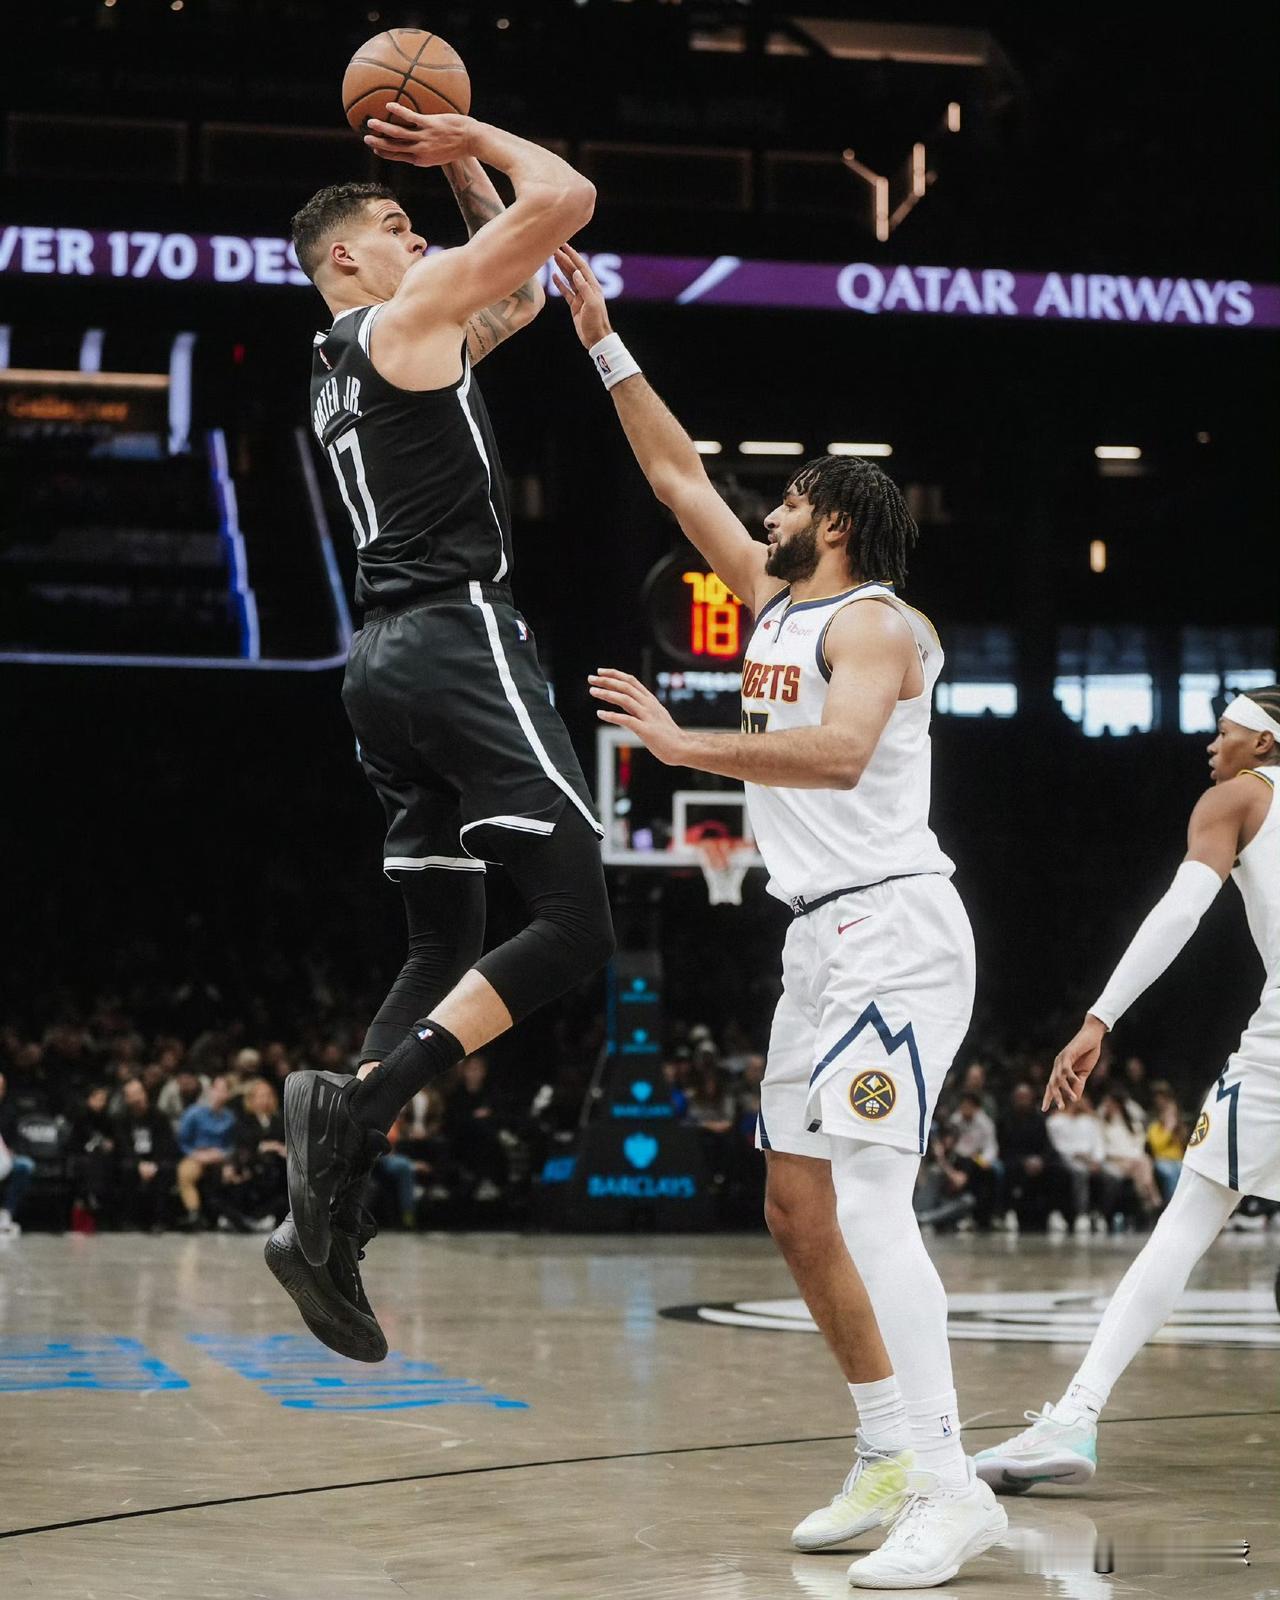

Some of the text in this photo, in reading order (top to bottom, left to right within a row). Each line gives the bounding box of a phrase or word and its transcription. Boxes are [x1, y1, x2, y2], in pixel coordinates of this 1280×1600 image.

[107, 231, 198, 280] 170
[837, 262, 1254, 325] QATAR AIRWAYS
[343, 375, 363, 417] JR.
[327, 427, 378, 550] 17
[692, 603, 738, 656] 18
